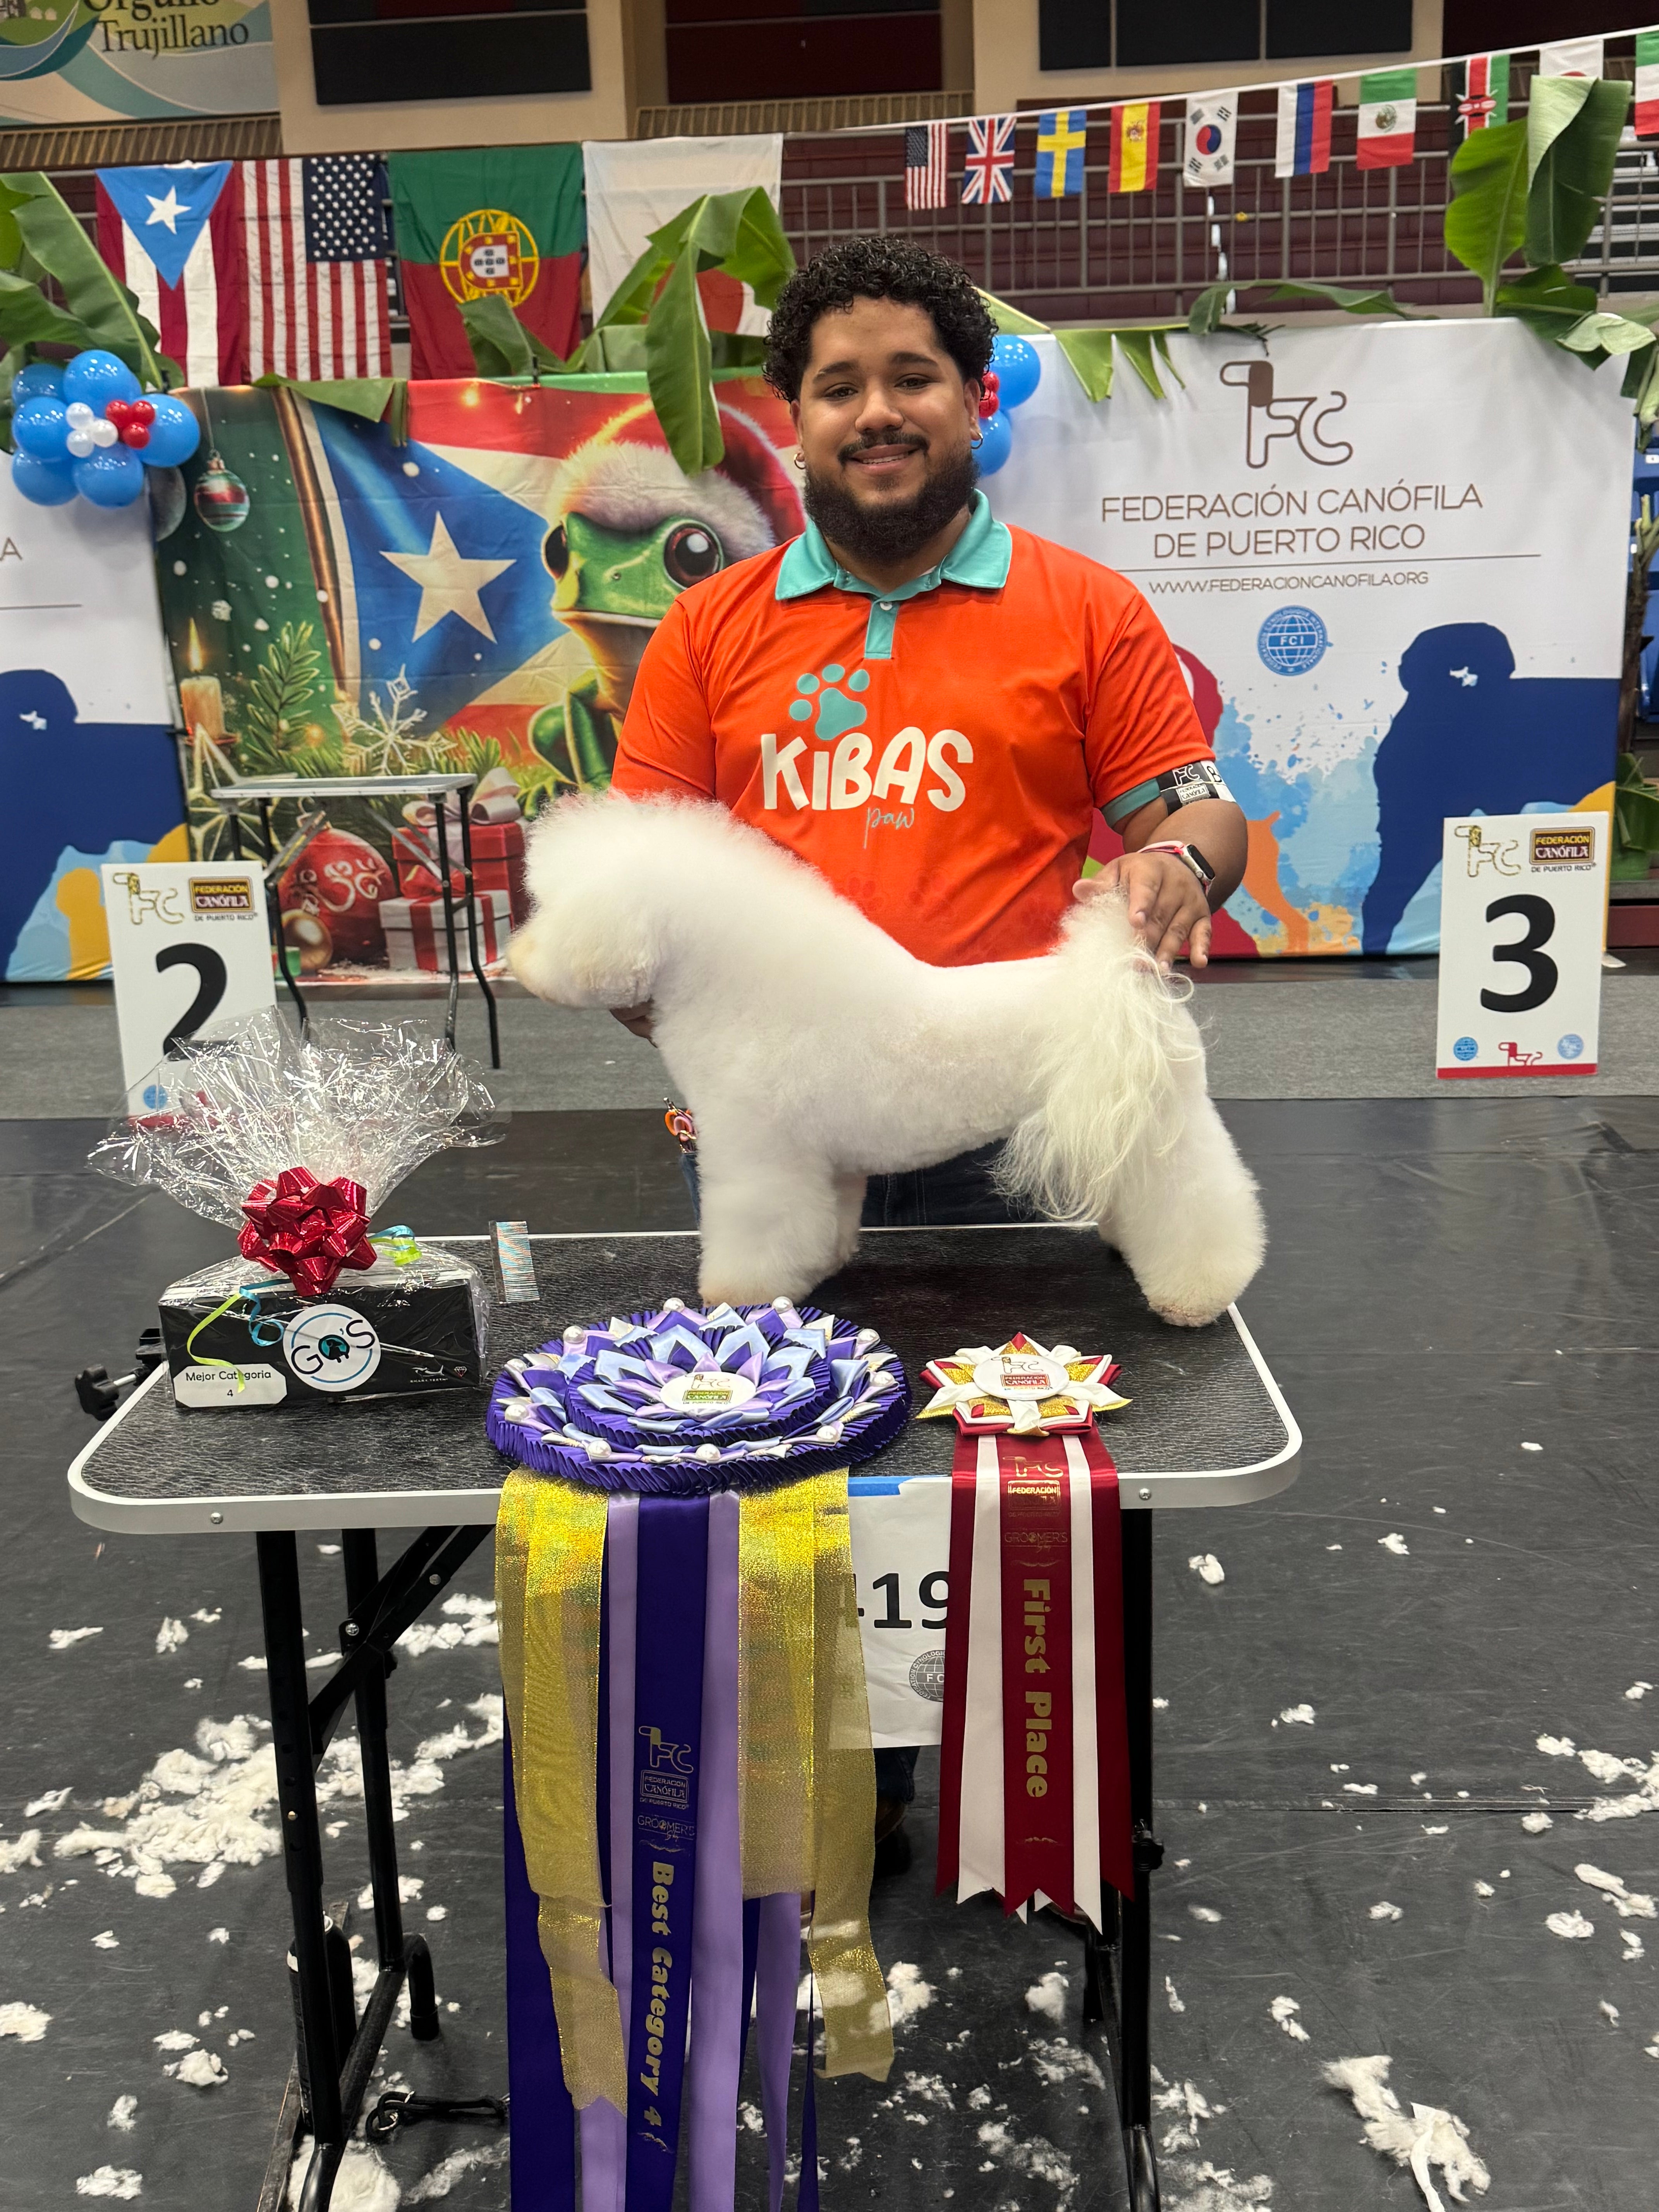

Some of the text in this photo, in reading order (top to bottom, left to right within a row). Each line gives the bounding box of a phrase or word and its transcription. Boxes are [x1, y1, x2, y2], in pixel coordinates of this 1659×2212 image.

[96, 14, 249, 60] Trujillano
[1102, 479, 1483, 522] FEDERACIÓN CANÓFILA
[1154, 524, 1425, 559] DE PUERTO RICO
[1280, 635, 1304, 646] FCI
[864, 807, 915, 849] paw
[1535, 845, 1589, 859] CANÓFILA
[1480, 893, 1558, 1013] 3
[156, 943, 237, 1061] 2
[186, 1370, 271, 1382] Mejor Catgoria
[1024, 1579, 1052, 1673] First
[1025, 1691, 1052, 1798] Place
[651, 1862, 674, 1936] Best
[640, 1947, 673, 2096] Category
[644, 2106, 662, 2127] 4
